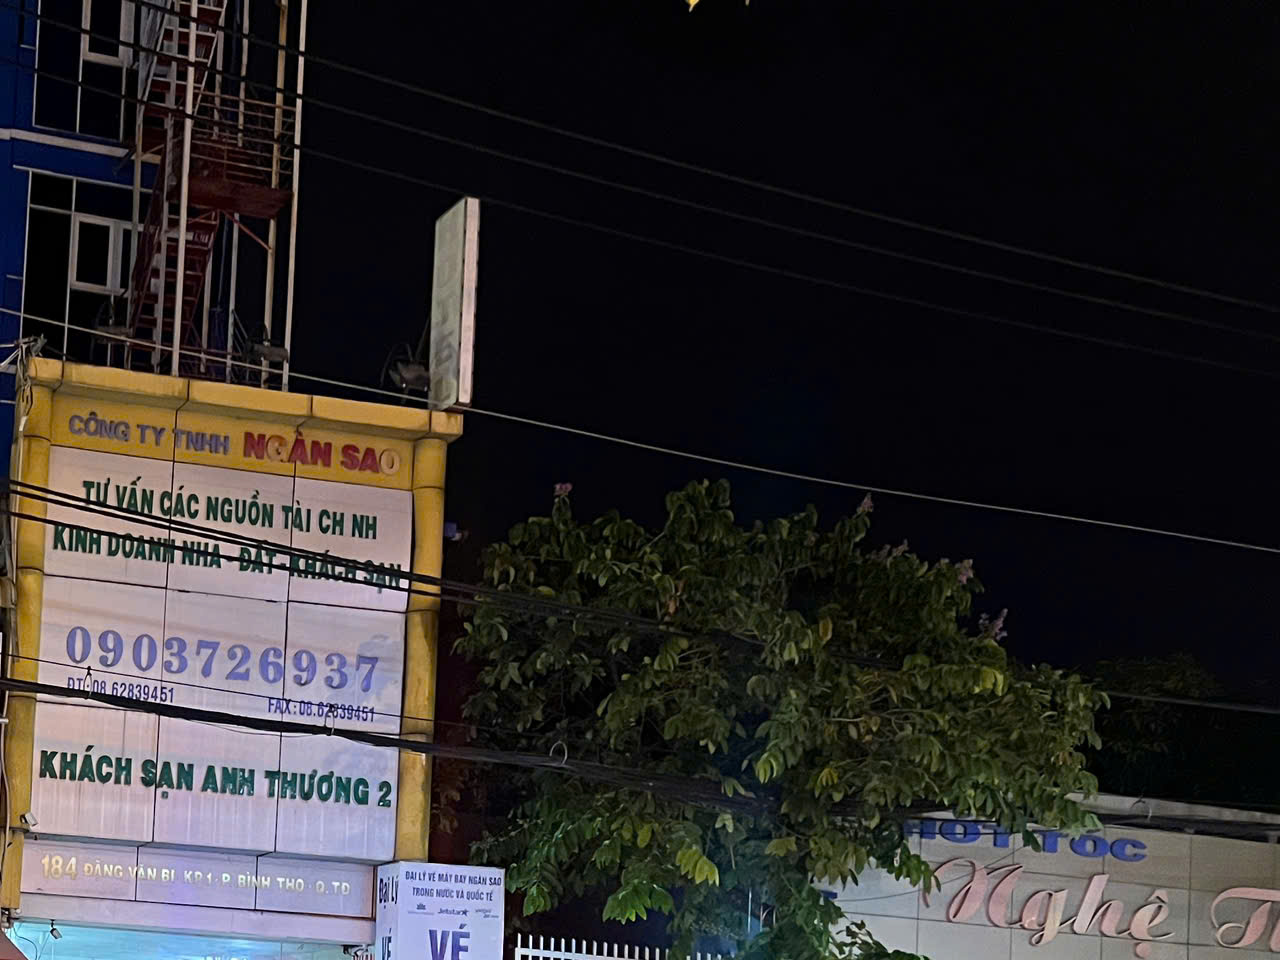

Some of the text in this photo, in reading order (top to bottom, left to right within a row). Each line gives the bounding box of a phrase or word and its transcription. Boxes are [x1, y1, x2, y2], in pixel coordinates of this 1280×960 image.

[68, 411, 130, 442] CÔNG
[136, 424, 166, 447] TY
[172, 428, 230, 455] TNHH
[340, 444, 400, 475] SAO
[159, 485, 199, 519] CÁC
[206, 490, 274, 528] NGUỒN
[282, 499, 311, 533] TÀI
[53, 523, 102, 555] KINH
[107, 532, 176, 564] DOANH
[66, 626, 379, 692] 0903726937
[39, 745, 392, 807] KHÁCH SẠN ANH THƯƠNG 2
[41, 855, 78, 880] 184
[921, 856, 1280, 960] Nghệ T
